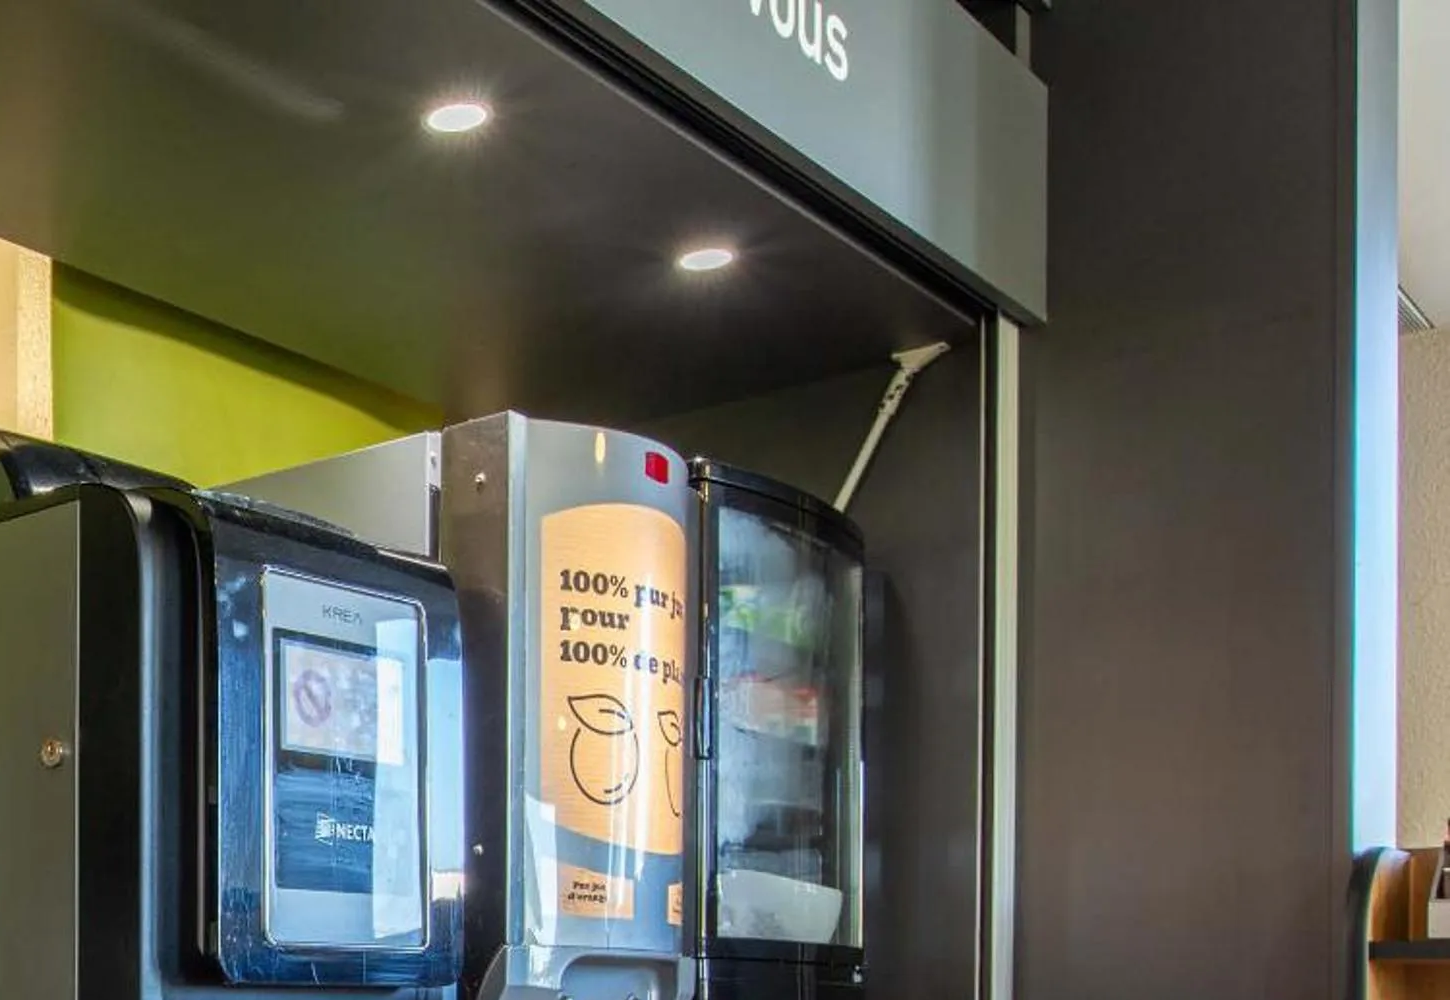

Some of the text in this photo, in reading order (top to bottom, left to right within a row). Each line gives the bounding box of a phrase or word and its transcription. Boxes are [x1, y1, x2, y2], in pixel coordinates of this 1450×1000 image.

[750, 0, 848, 81] ous
[560, 569, 629, 598] 100%
[560, 639, 628, 668] 100%
